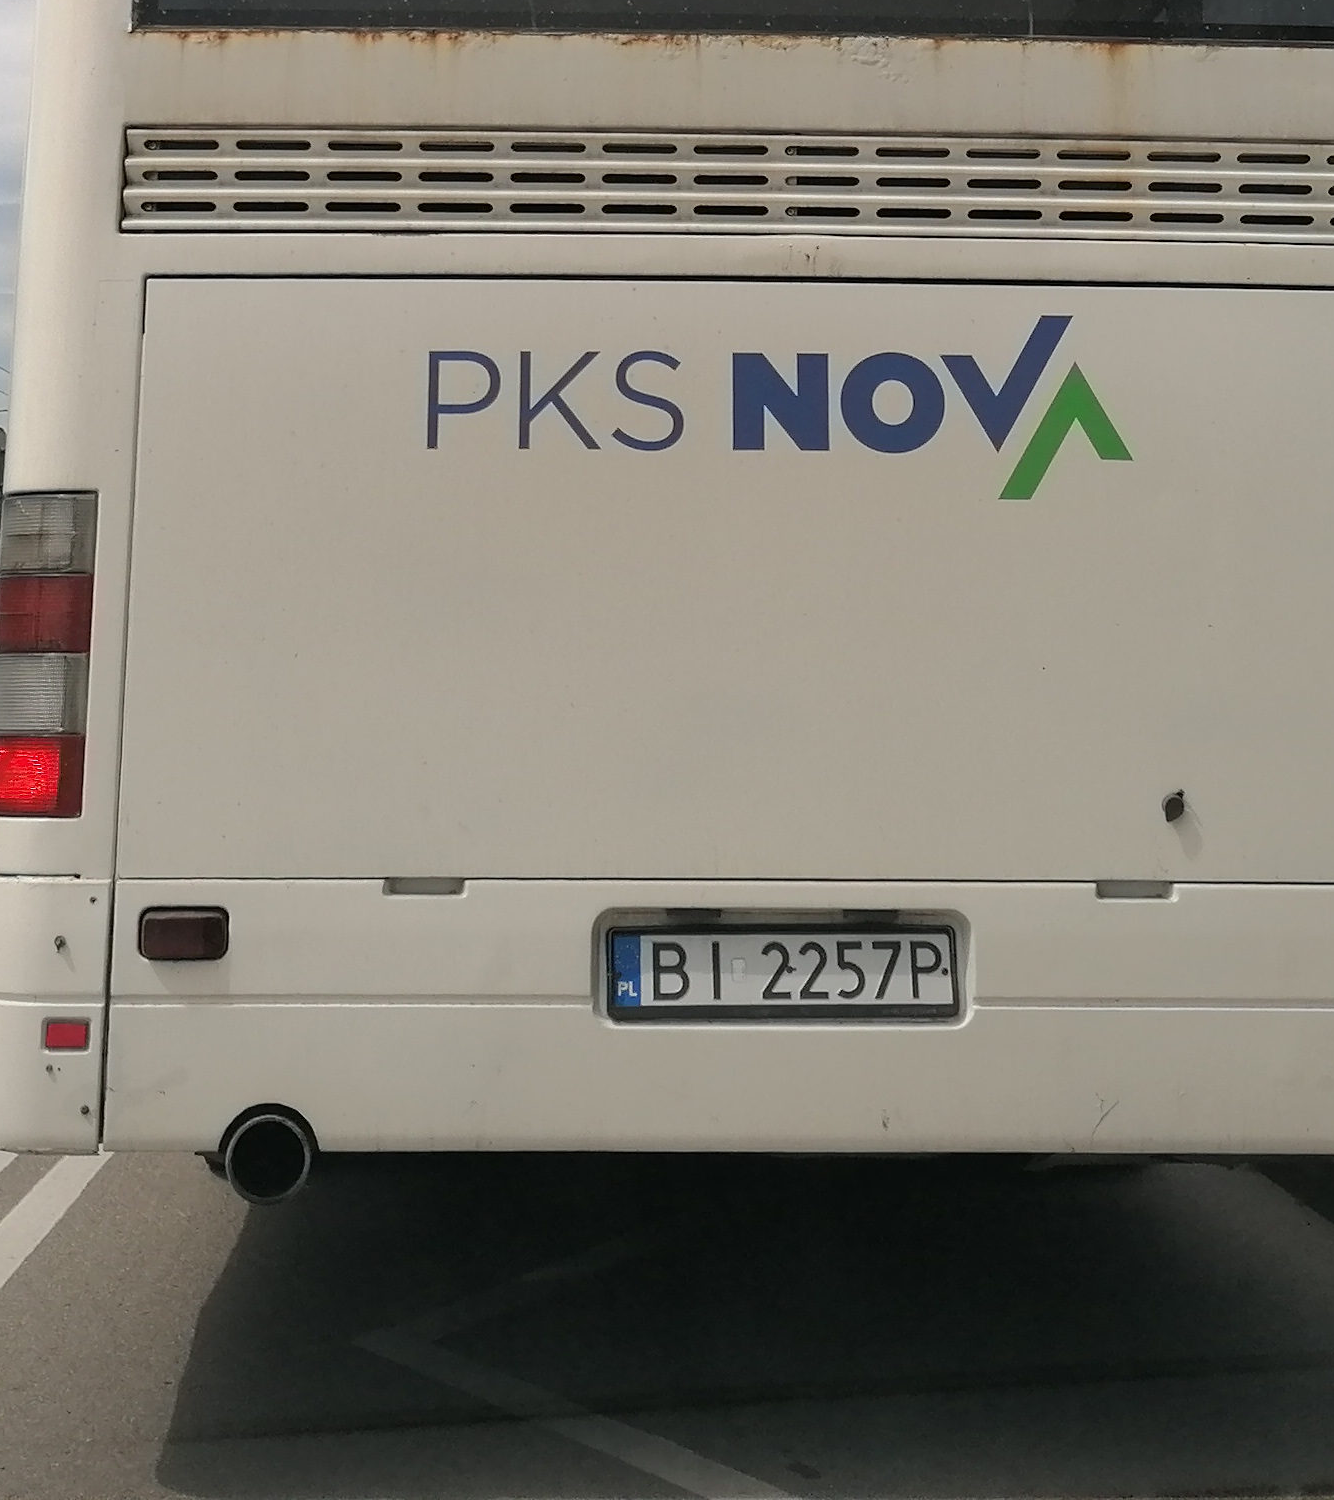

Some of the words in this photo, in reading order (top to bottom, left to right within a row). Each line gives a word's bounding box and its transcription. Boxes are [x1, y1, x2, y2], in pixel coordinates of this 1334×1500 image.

[426, 350, 685, 452] PKS
[731, 315, 1134, 500] NOVA
[616, 981, 638, 998] PL
[652, 941, 721, 1000] BI
[761, 940, 943, 1000] 2257P
